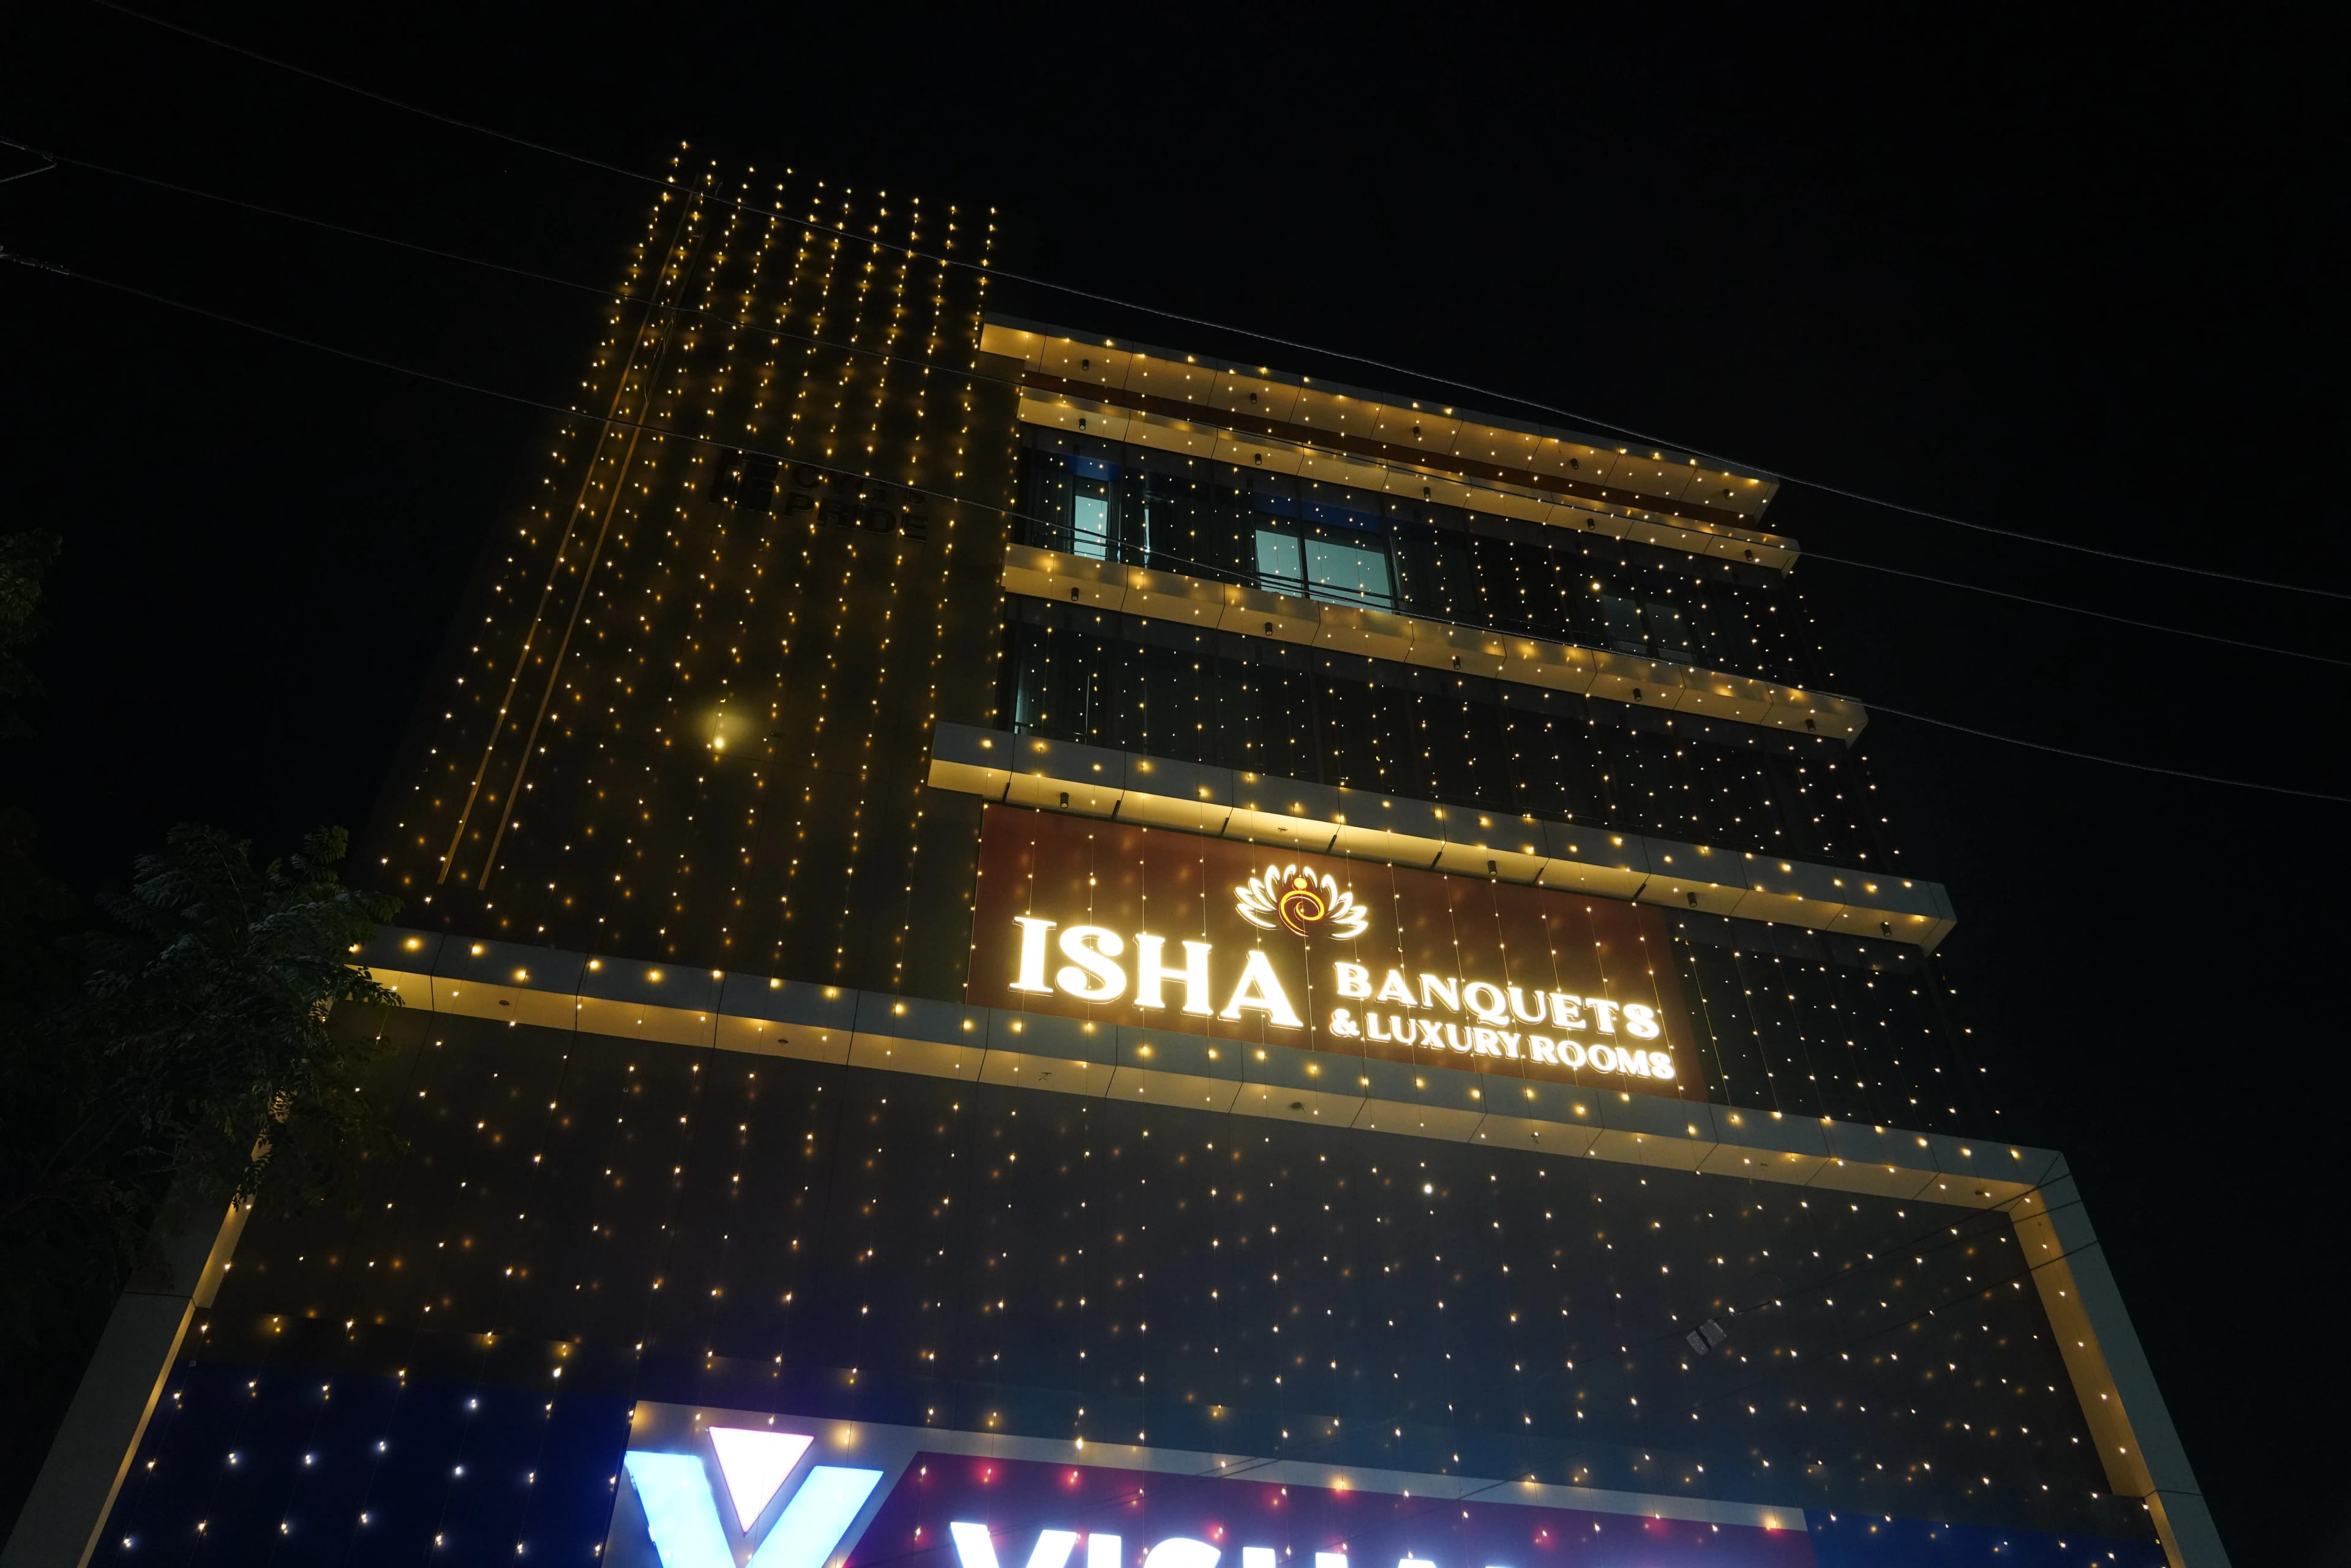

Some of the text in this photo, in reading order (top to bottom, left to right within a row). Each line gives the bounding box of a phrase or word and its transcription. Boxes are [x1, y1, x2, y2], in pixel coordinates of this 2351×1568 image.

[784, 492, 929, 542] PRIDE
[1008, 916, 1304, 1030] ISHA
[1334, 961, 1660, 1040] BANQUETS
[1365, 1011, 1523, 1060] LUXURY
[1529, 1035, 1676, 1080] ROOMS
